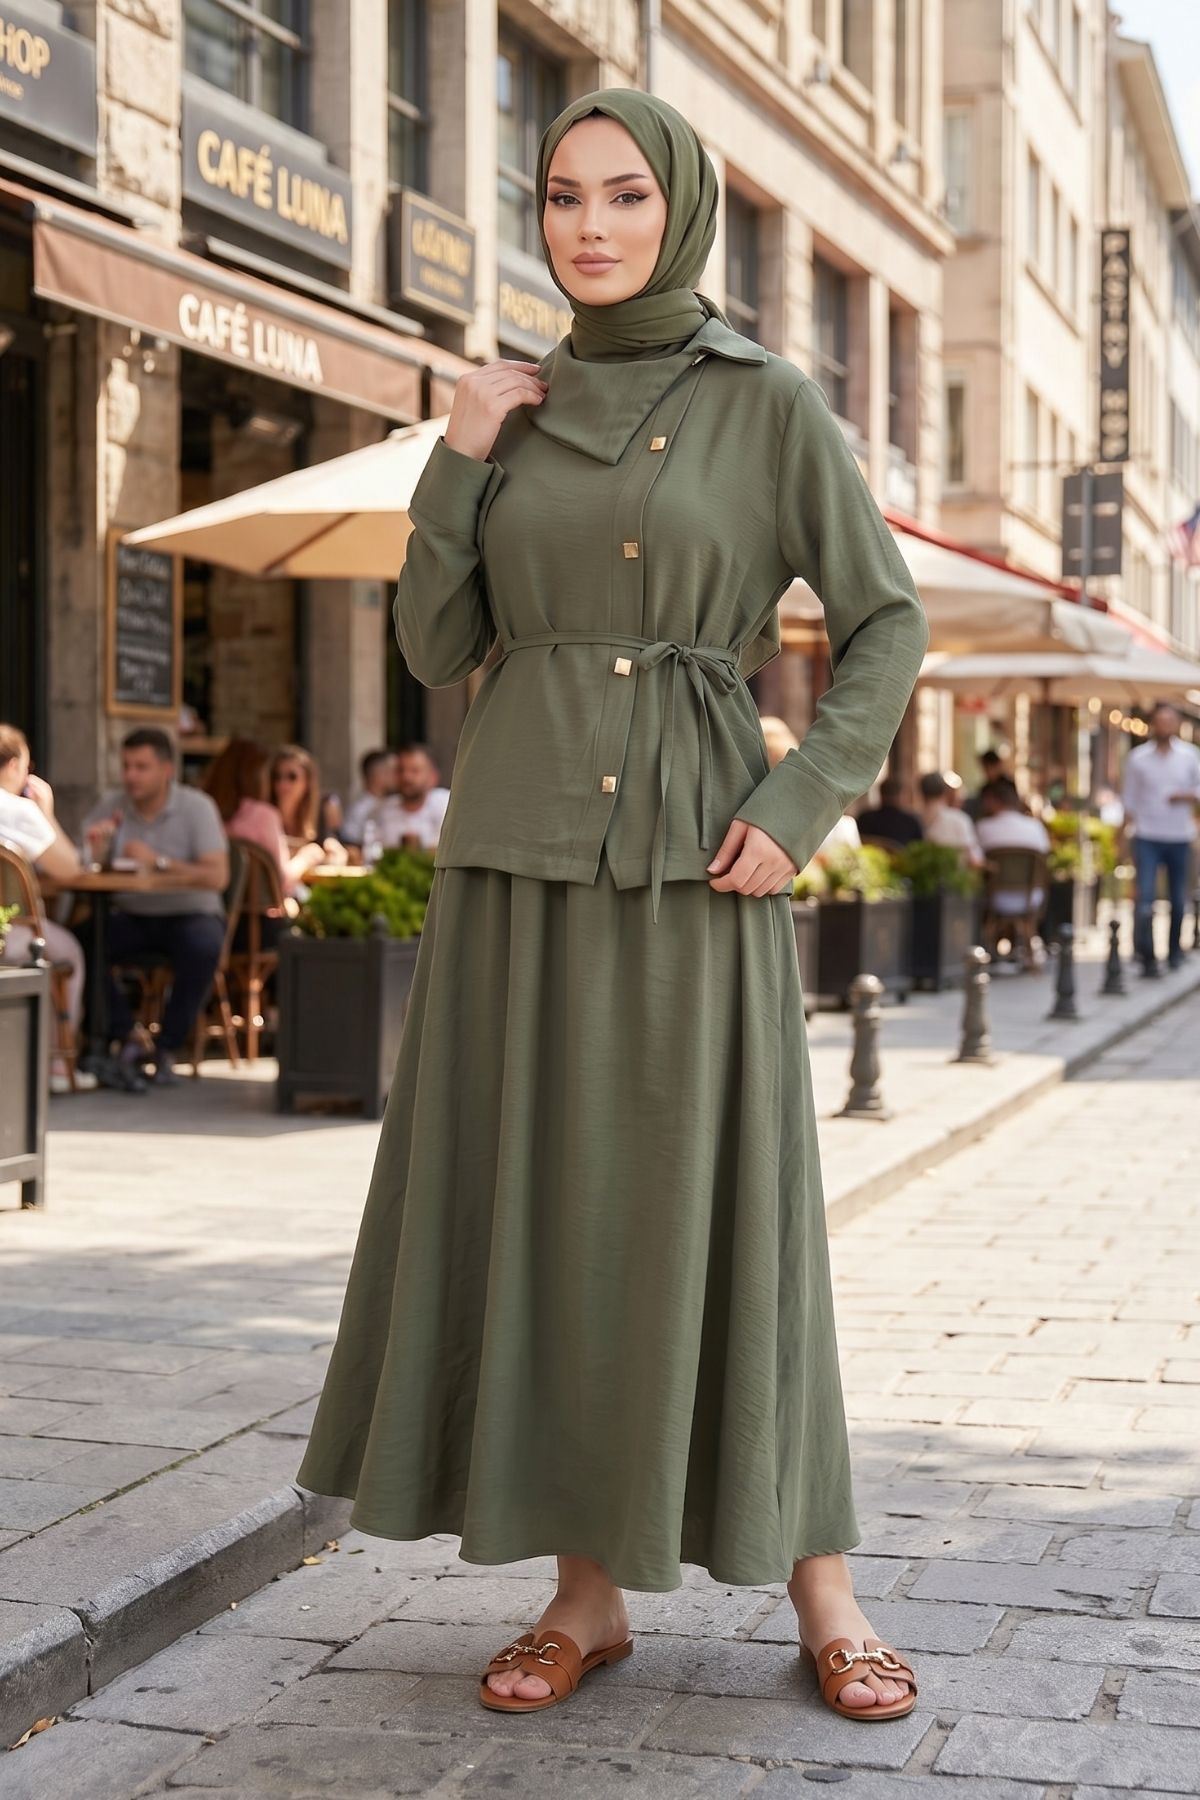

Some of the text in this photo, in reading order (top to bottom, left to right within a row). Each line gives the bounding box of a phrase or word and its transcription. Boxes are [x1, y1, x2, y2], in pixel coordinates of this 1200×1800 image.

[198, 129, 348, 245] CAFÉ LUNA
[178, 293, 323, 384] CAFÉ LUNA
